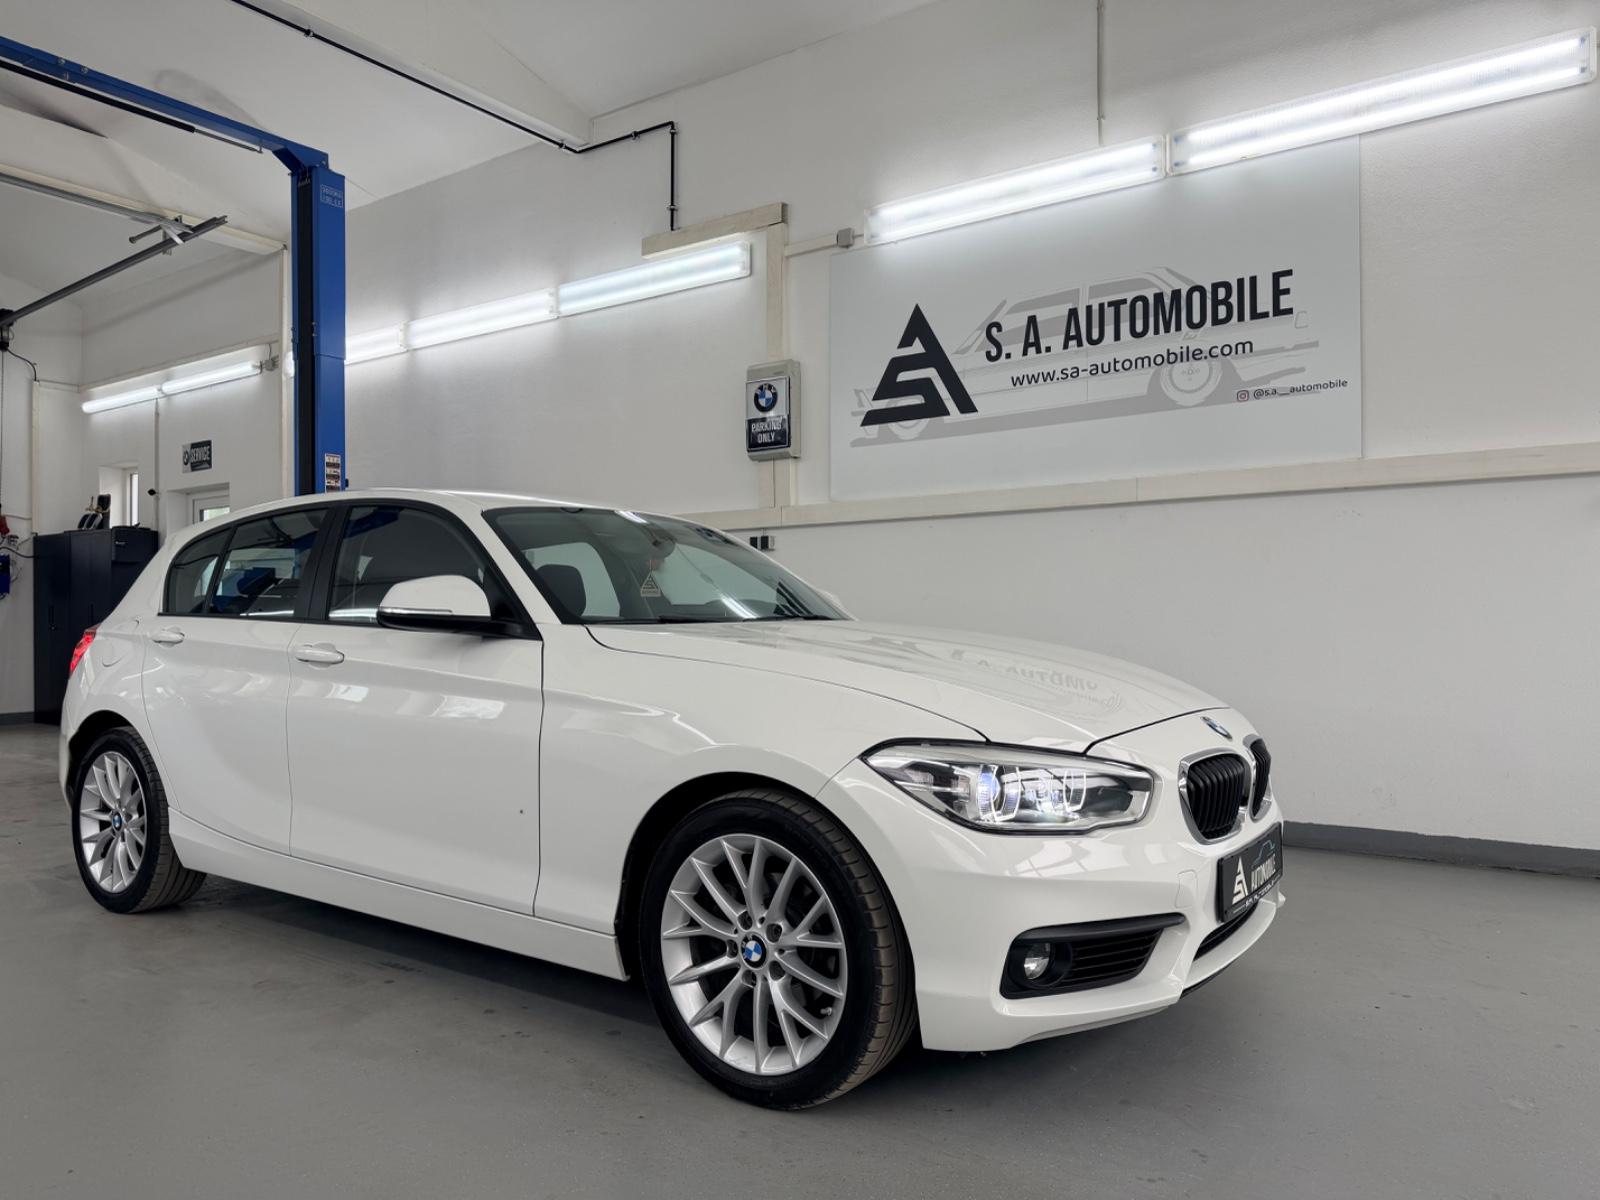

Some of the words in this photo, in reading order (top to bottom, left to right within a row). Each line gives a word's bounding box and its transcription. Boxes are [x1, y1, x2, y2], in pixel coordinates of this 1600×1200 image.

[985, 320, 1012, 363] S.
[1022, 314, 1051, 357] A.
[1062, 268, 1294, 351] AUTOMOBILE
[1011, 340, 1254, 388] www.sa-automobile.com
[751, 420, 782, 432] PARKING
[757, 432, 775, 444] ONLY
